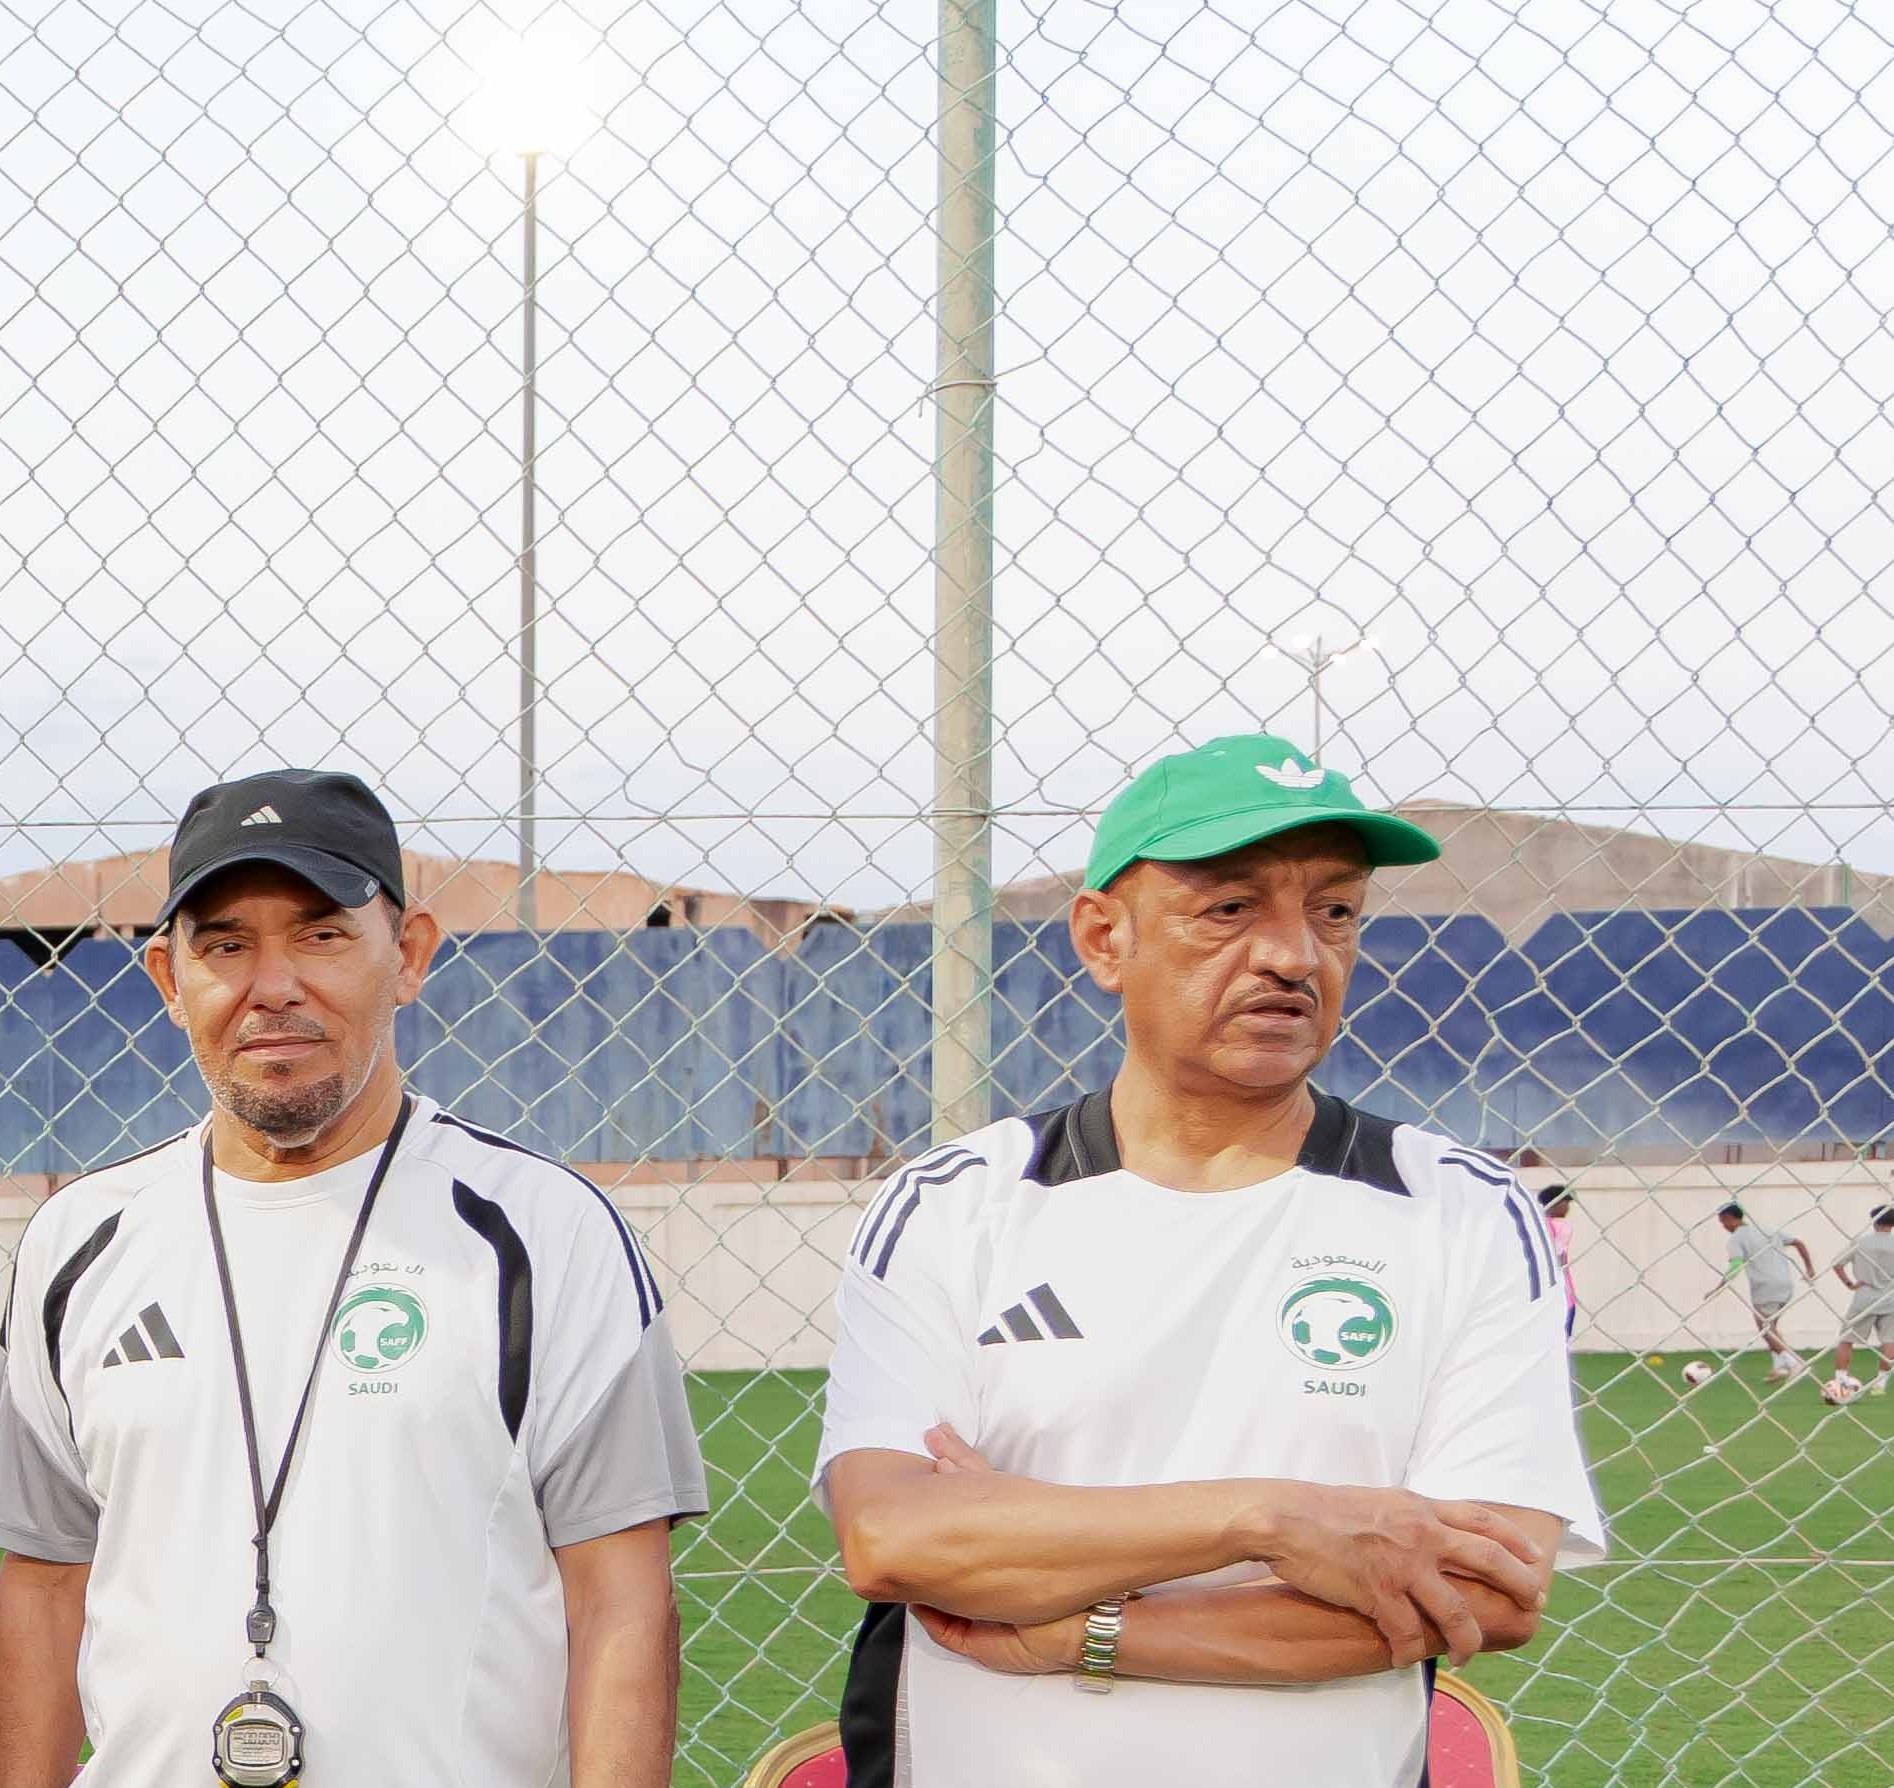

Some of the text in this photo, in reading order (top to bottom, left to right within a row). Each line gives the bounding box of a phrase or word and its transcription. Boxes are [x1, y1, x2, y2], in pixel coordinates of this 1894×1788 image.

[1290, 1255, 1388, 1274] السعودية
[379, 1337, 408, 1347] SAFF
[1339, 1331, 1377, 1342] SAFF
[348, 1381, 399, 1396] SAUDI
[1303, 1380, 1367, 1397] SAUDI
